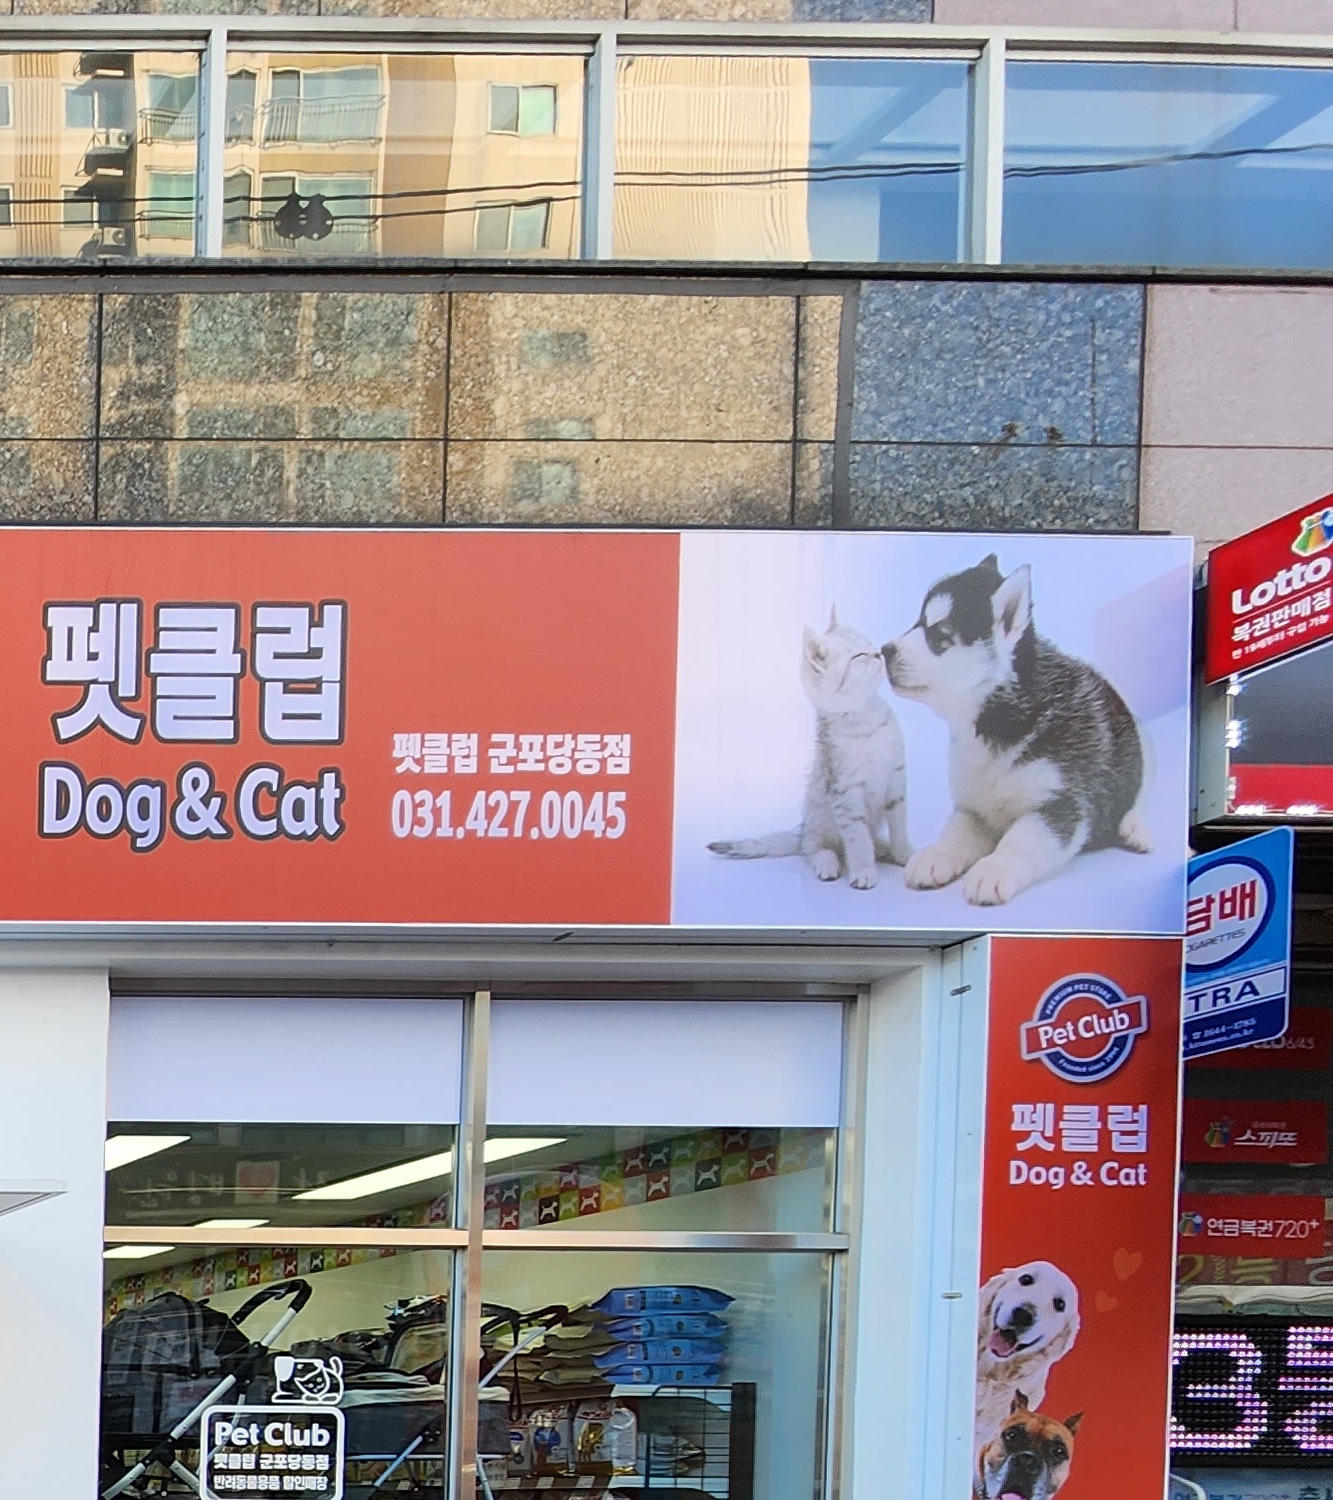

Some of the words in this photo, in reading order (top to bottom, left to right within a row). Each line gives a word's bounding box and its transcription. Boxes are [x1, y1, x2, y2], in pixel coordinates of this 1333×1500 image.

[1231, 556, 1333, 614] Lotto
[1231, 587, 1332, 642] 복권판매점
[41, 598, 349, 745] 펫클럽
[392, 733, 478, 775] 펫클럽
[487, 732, 632, 775] 군포당동점
[390, 789, 628, 840] 031.427.0045
[1037, 1021, 1077, 1049] Pet
[1078, 1008, 1130, 1039] Club
[1010, 1103, 1148, 1153] 펫클럽
[1009, 1160, 1067, 1190] Dog
[1070, 1161, 1095, 1186] &
[1099, 1160, 1148, 1186] Cat
[214, 1421, 260, 1446] Pet
[264, 1421, 331, 1447] Club
[213, 1453, 256, 1470] 펫클럽
[259, 1453, 330, 1471] 군포당동점
[213, 1474, 281, 1491] 반려동물용품
[282, 1475, 329, 1491] 할인매장
